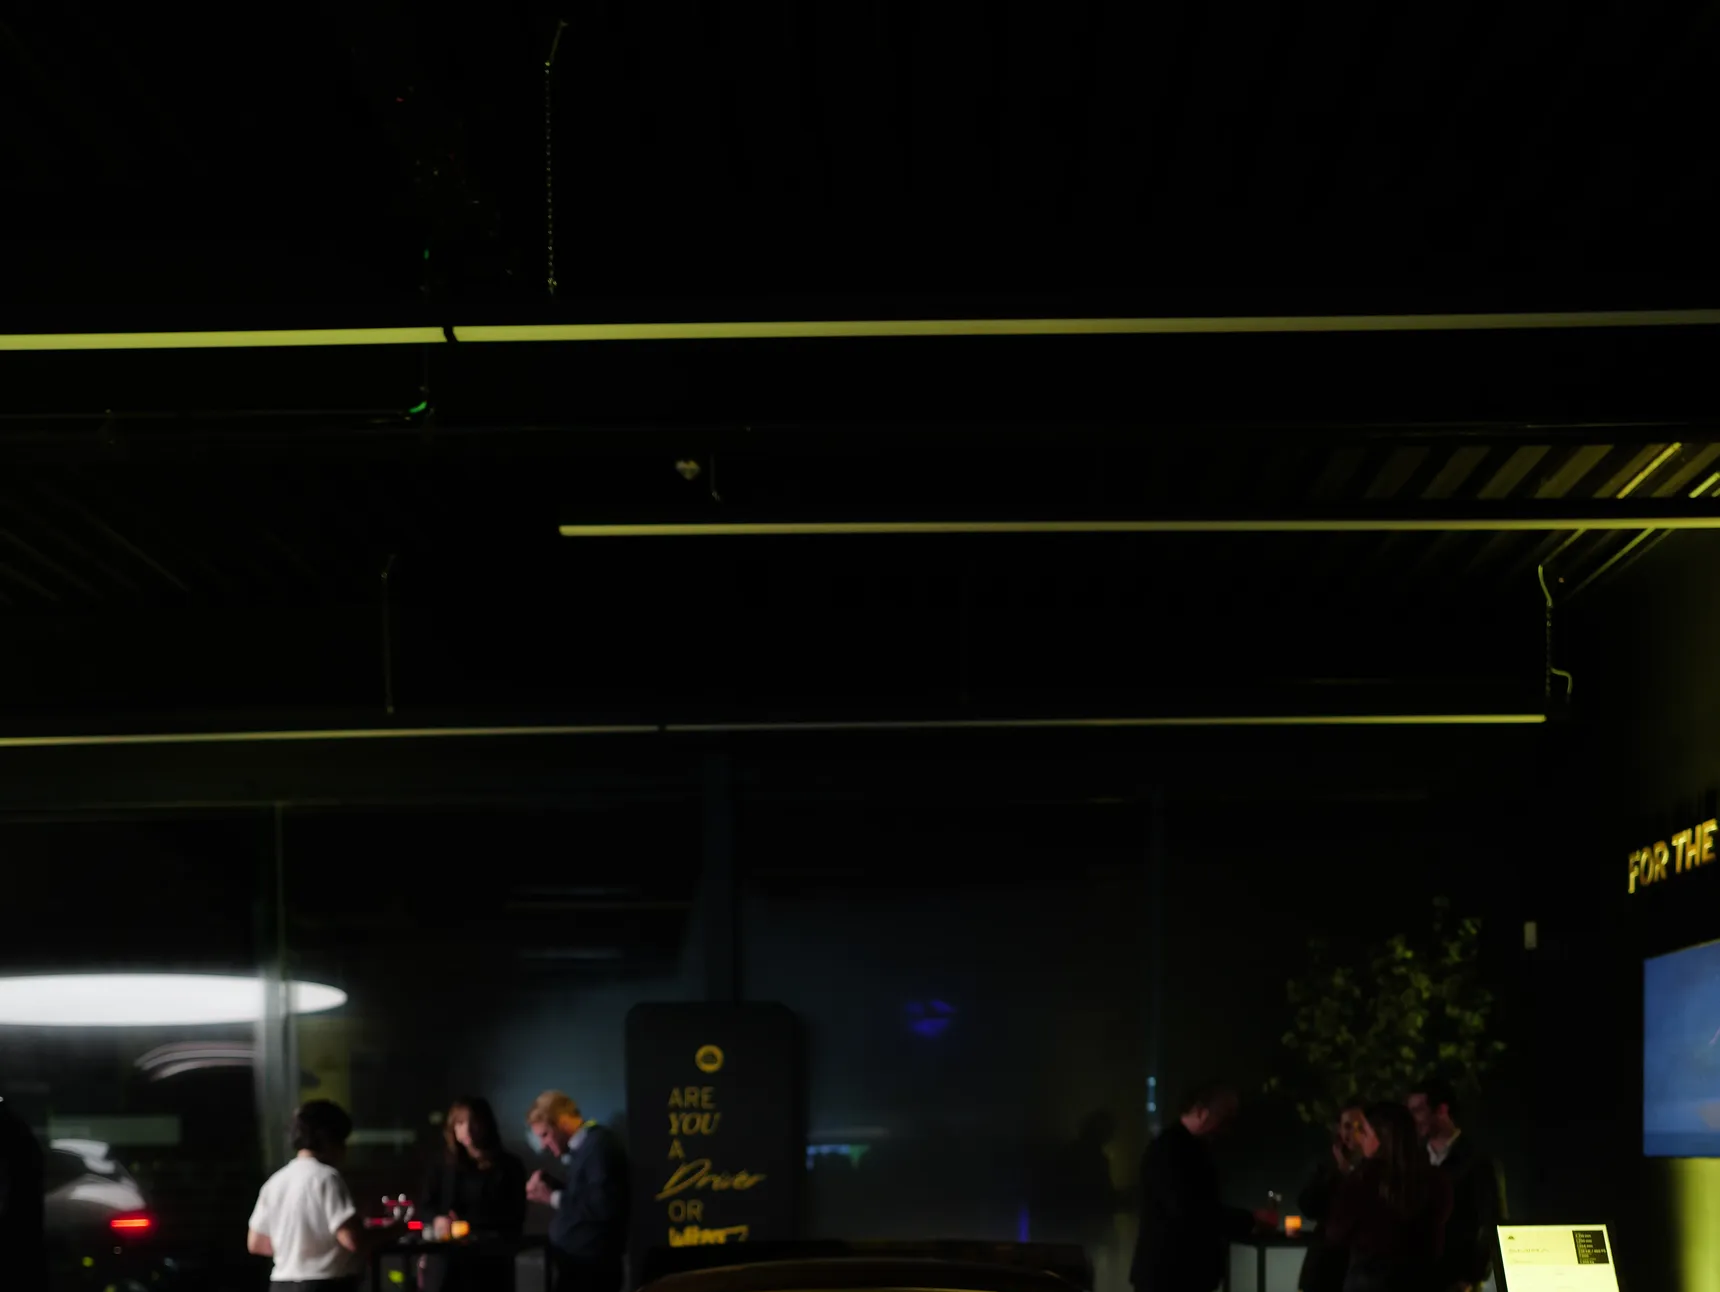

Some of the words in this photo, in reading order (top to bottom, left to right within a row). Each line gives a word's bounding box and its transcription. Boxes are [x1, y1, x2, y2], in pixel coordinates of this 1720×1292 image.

[1628, 841, 1669, 894] FOR
[1671, 818, 1718, 874] THE
[668, 1086, 716, 1110] ARE
[668, 1112, 721, 1136] YOU
[668, 1138, 686, 1160] A
[667, 1199, 704, 1223] OR
